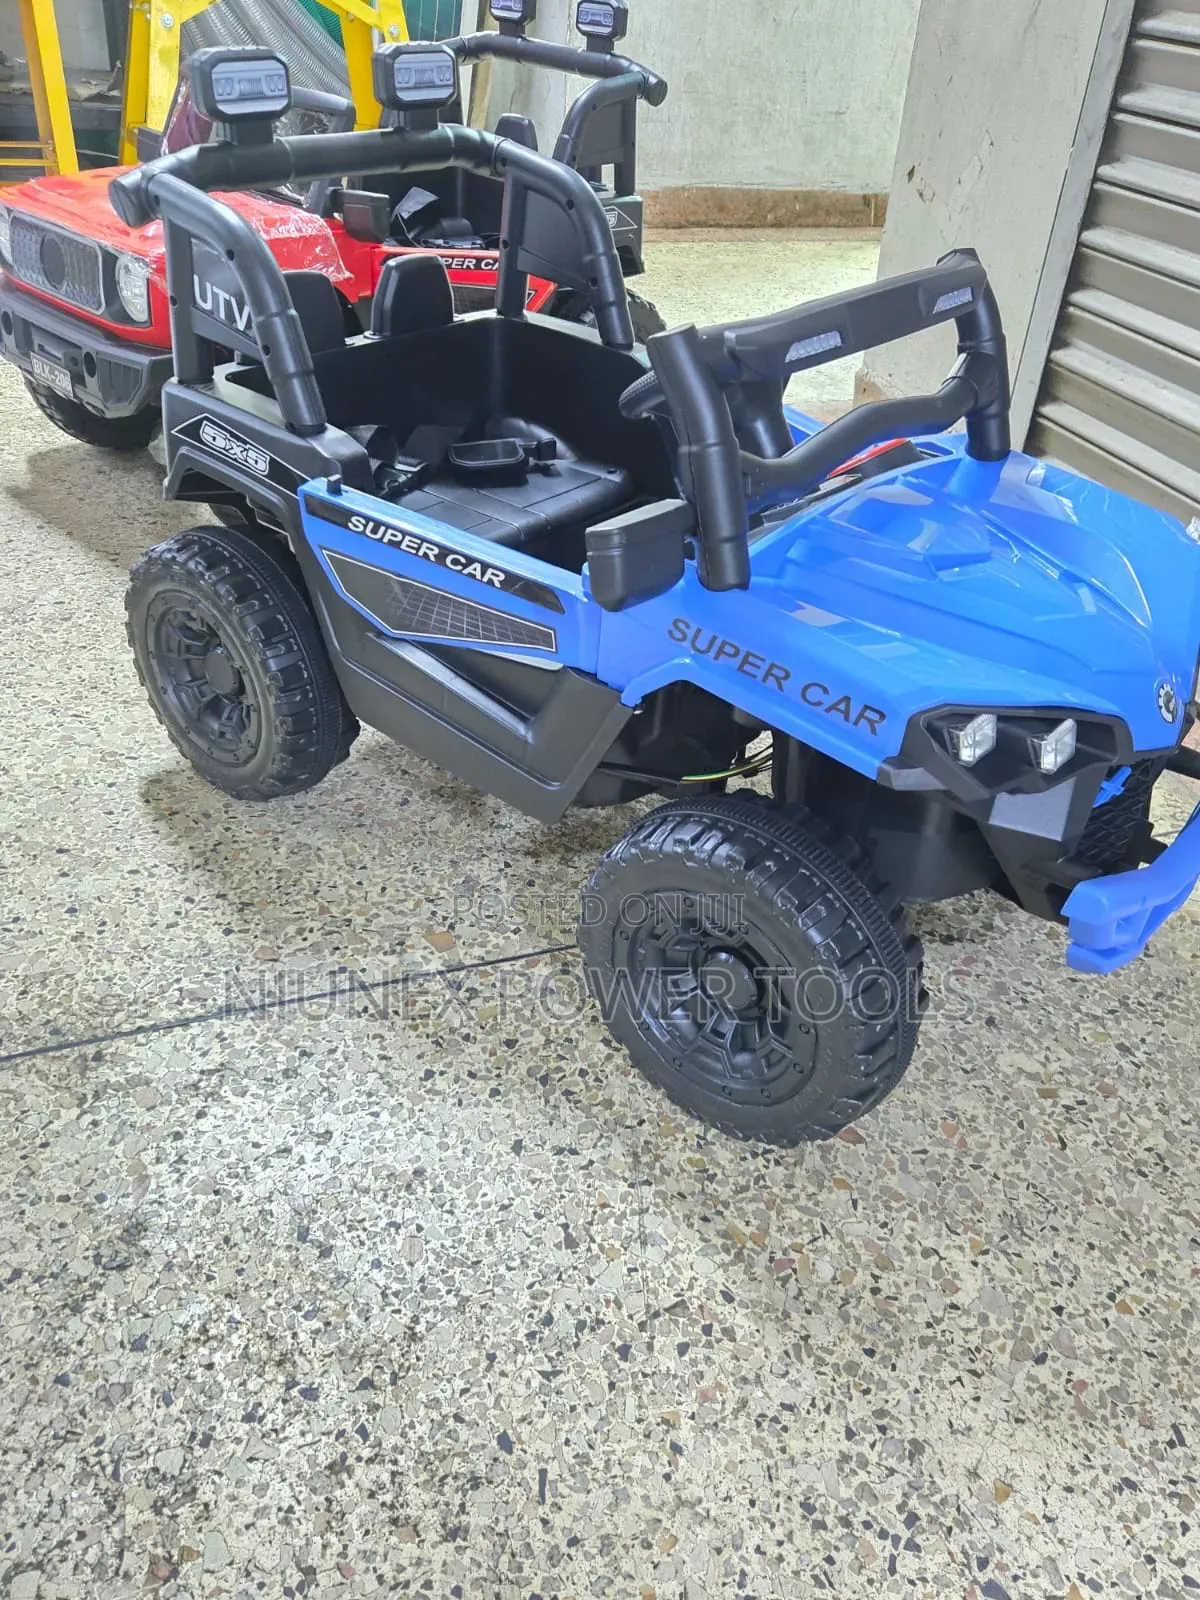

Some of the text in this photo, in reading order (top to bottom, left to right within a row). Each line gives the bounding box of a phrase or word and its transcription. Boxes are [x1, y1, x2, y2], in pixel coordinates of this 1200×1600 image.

[193, 273, 250, 331] UTV
[347, 515, 505, 588] SUPER CAR
[667, 617, 887, 737] SUPER CAR
